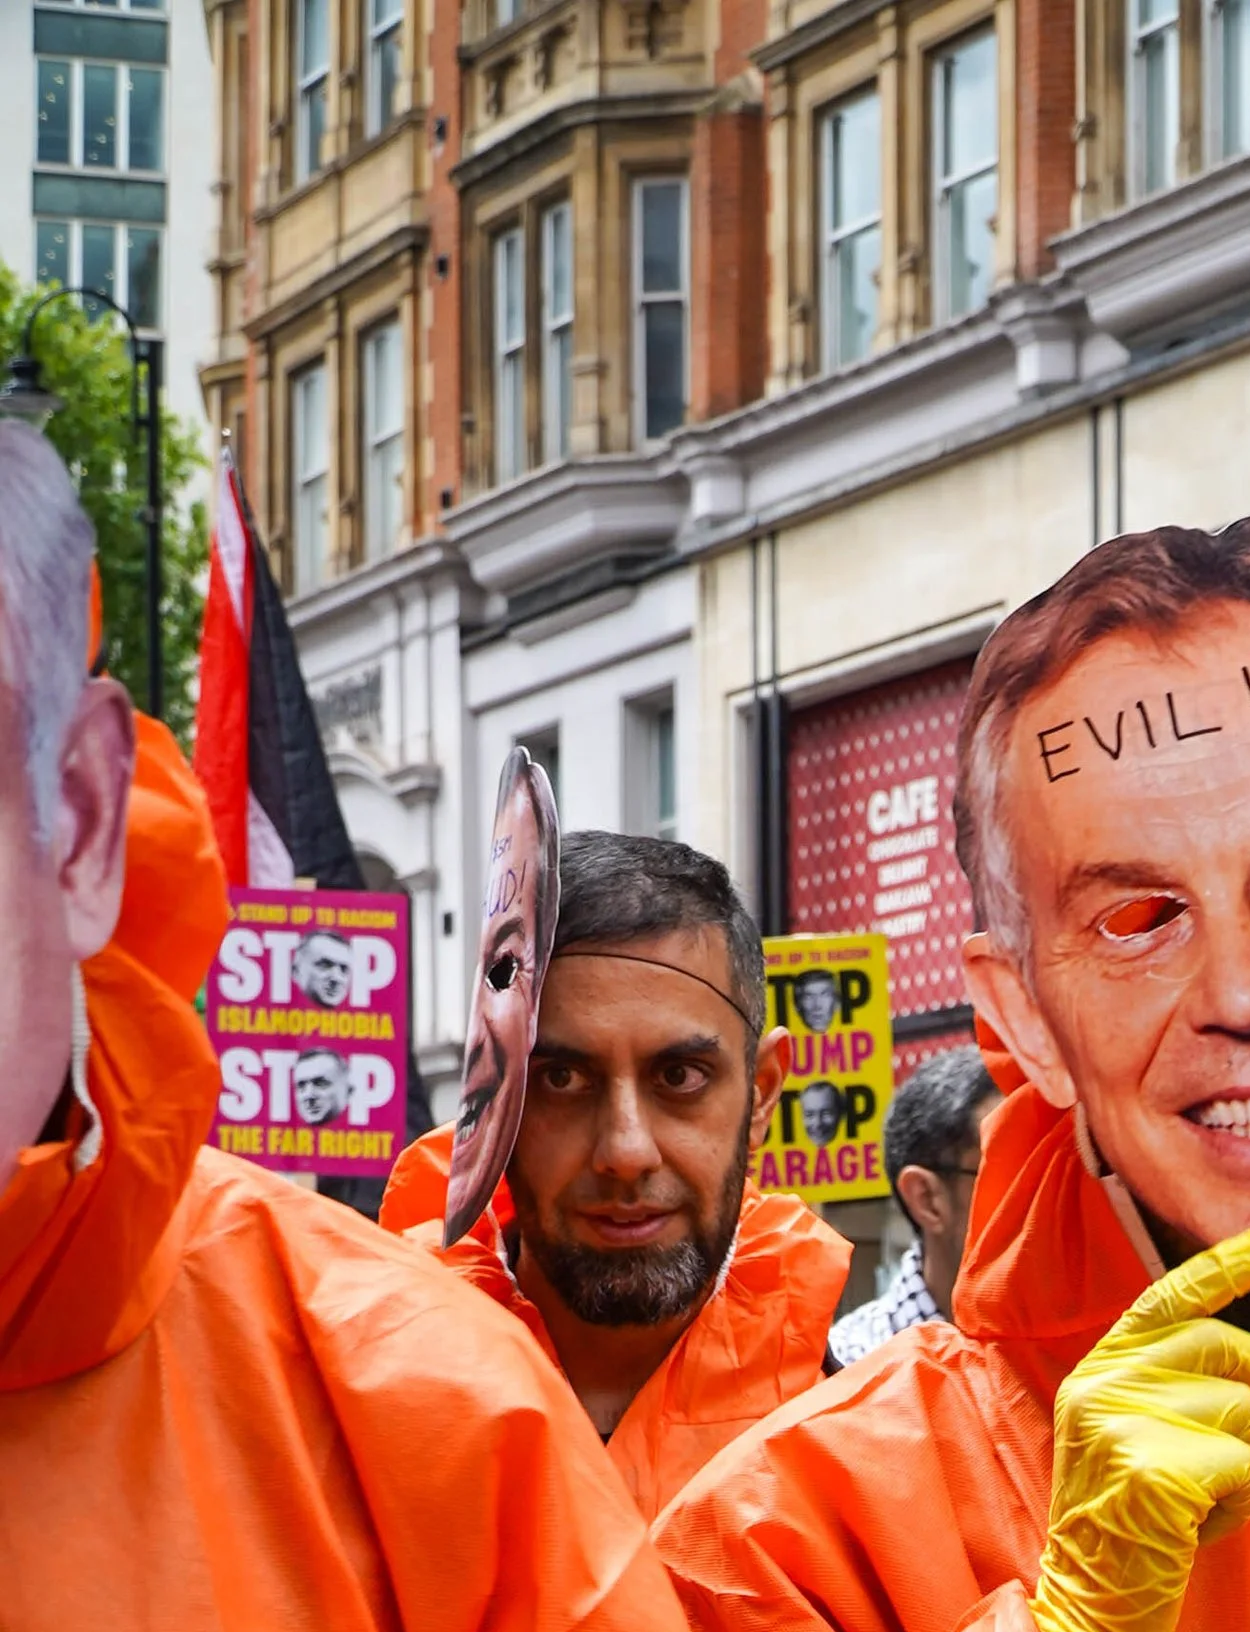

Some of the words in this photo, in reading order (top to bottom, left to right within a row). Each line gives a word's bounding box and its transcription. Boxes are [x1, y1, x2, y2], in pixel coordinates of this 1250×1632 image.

[1036, 691, 1223, 783] EVIL
[867, 775, 939, 835] CAFE
[218, 927, 397, 1008] STP
[217, 1005, 396, 1040] ISLAMOPHOBIA
[789, 1029, 875, 1077] UMP
[218, 1046, 396, 1126] STP
[219, 1125, 263, 1154] THE
[268, 1127, 314, 1156] FAR
[318, 1130, 394, 1160] RIGHT
